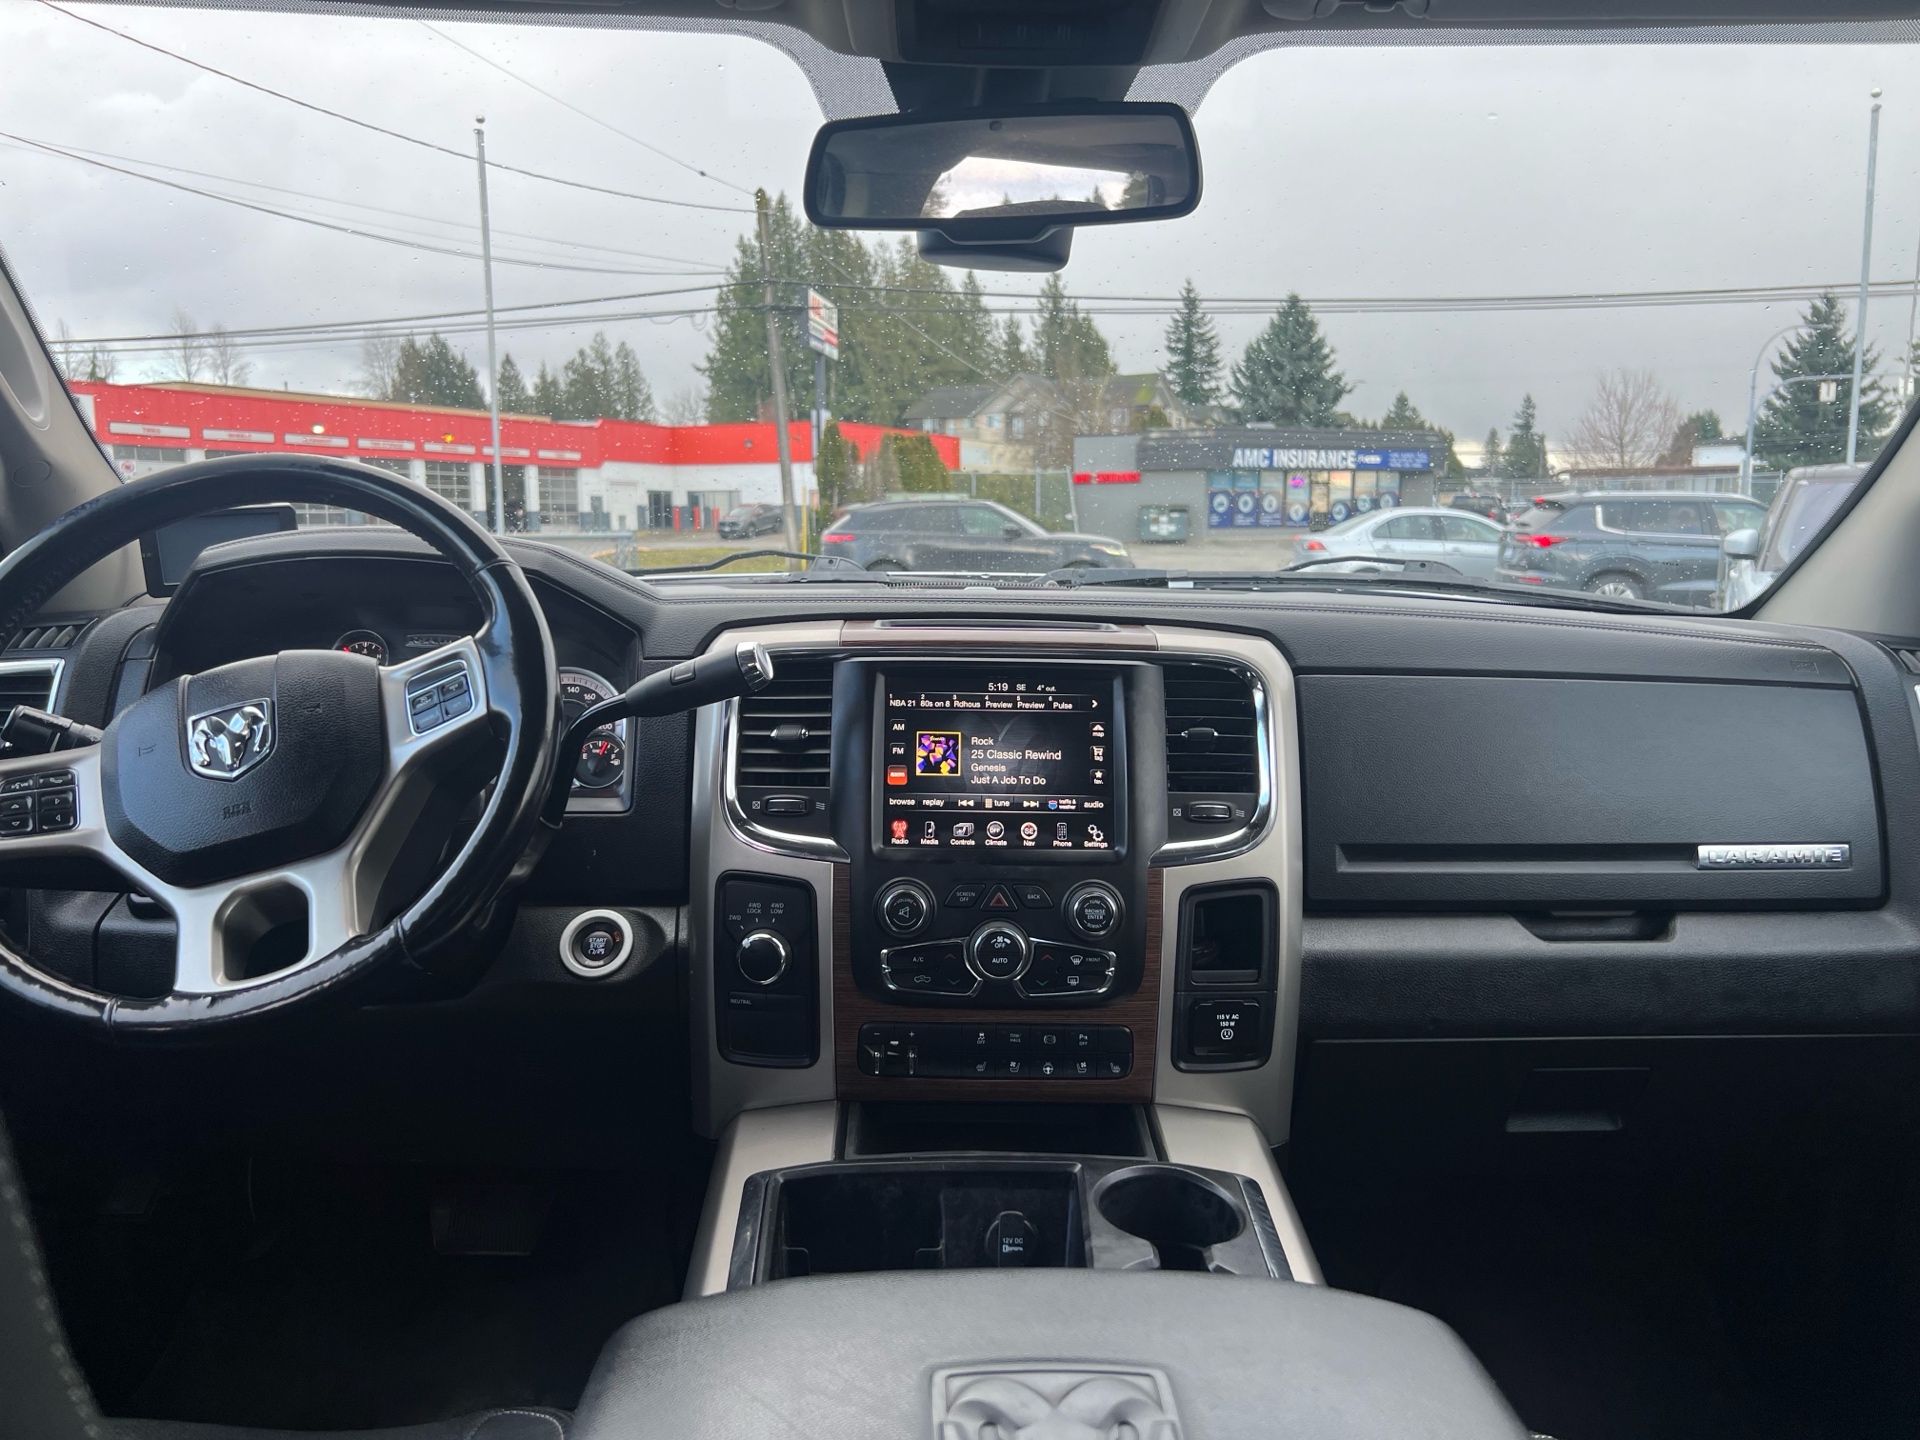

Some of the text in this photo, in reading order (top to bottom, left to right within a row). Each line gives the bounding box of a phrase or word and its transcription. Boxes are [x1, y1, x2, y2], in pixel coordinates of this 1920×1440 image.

[1232, 448, 1270, 468] AMC
[1272, 449, 1357, 469] INSURANCE
[988, 682, 1008, 691] 5:19
[1016, 683, 1027, 691] SE
[953, 700, 981, 708] Rdhous
[985, 700, 1013, 709] Preview
[1017, 701, 1045, 709] Preview
[1053, 701, 1073, 710] Pulse
[892, 723, 905, 731] AM
[971, 736, 994, 745] Rock
[892, 747, 904, 755] FM
[971, 749, 1062, 760] 25 Classic Rewind
[971, 763, 1006, 772] Genesis
[971, 775, 1046, 785] Just A Job To Do
[922, 798, 944, 807] replay
[994, 799, 1010, 807] tune
[1707, 848, 1843, 864] LARAMIE
